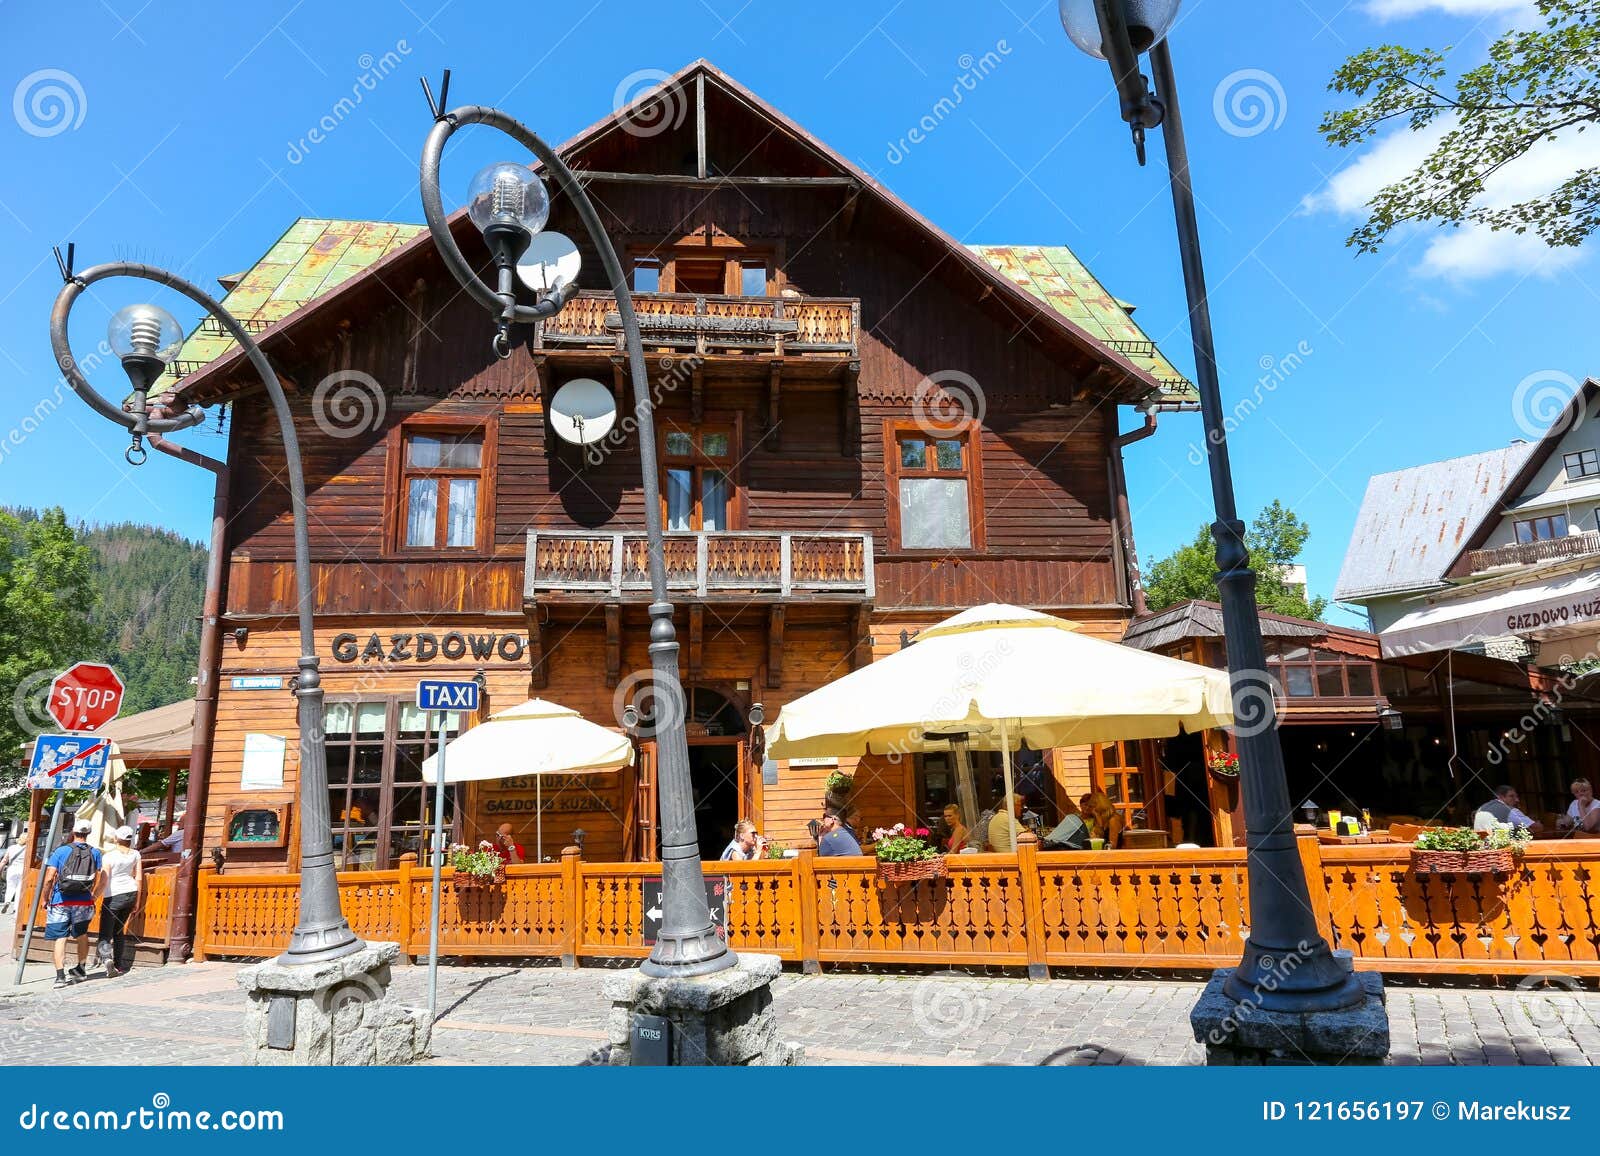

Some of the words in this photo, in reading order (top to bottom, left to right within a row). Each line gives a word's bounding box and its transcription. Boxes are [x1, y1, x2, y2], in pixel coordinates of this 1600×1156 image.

[1507, 606, 1569, 630] GAZDOWO
[332, 631, 524, 662] GAZDOWO
[58, 686, 116, 710] STOP
[425, 685, 473, 706] TAXI
